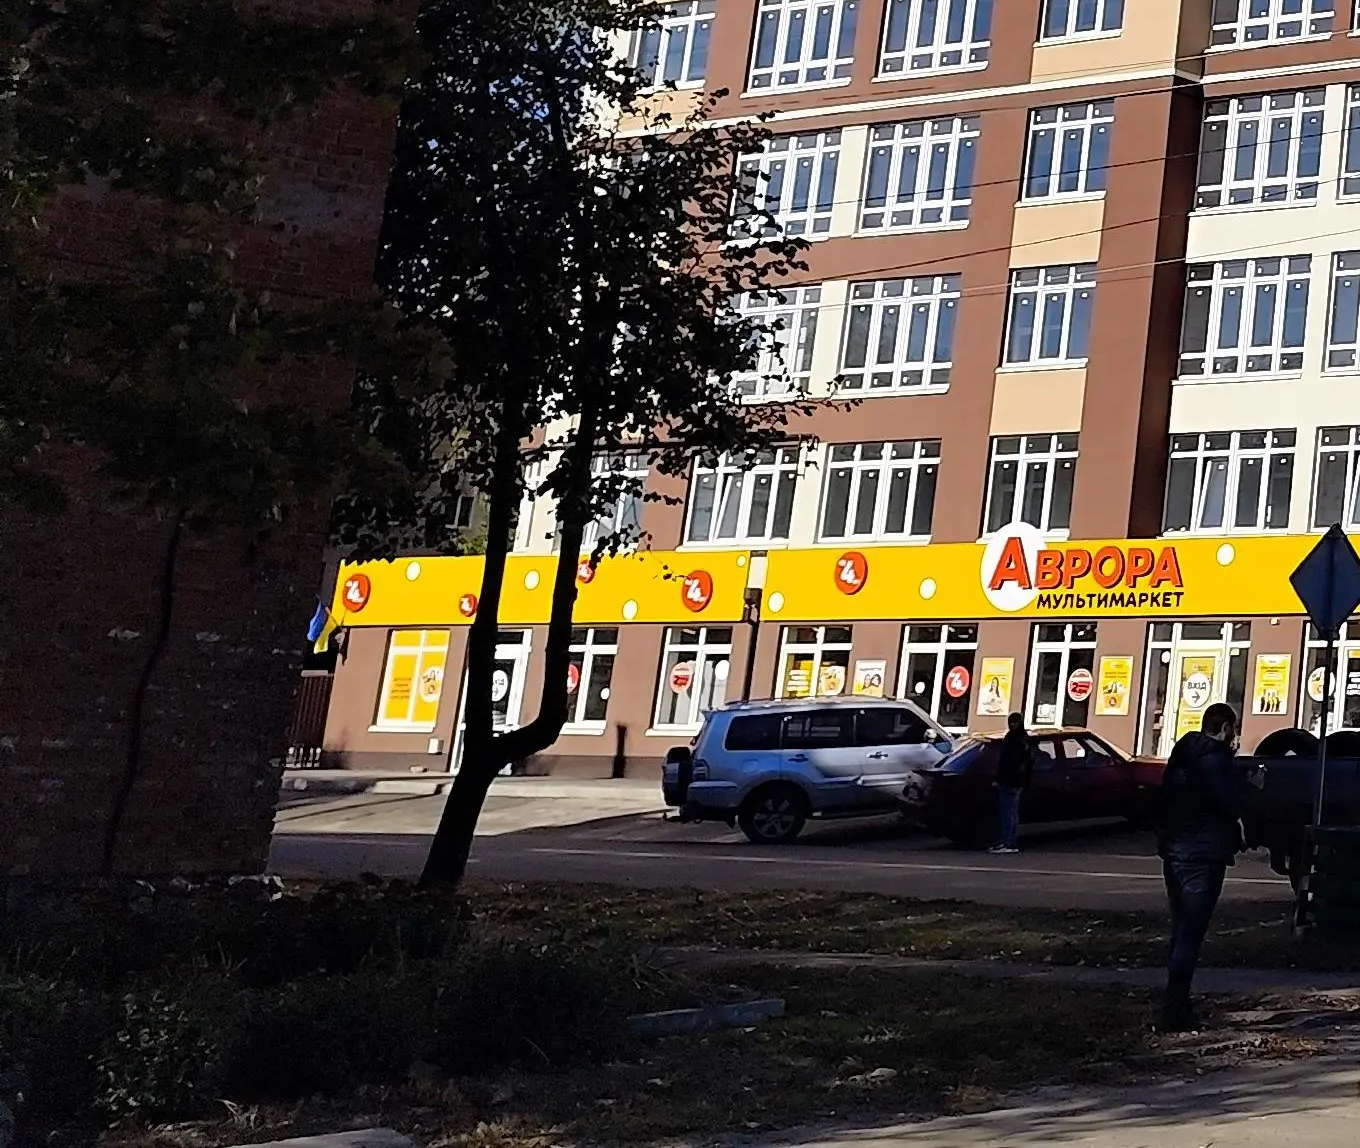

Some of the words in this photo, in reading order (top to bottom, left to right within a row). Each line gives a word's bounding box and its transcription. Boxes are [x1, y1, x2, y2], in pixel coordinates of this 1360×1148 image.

[988, 536, 1184, 590] АВРОРА
[1037, 591, 1184, 610] МУЛЬТИМАРКЕТ
[1187, 682, 1207, 691] ВХІД
